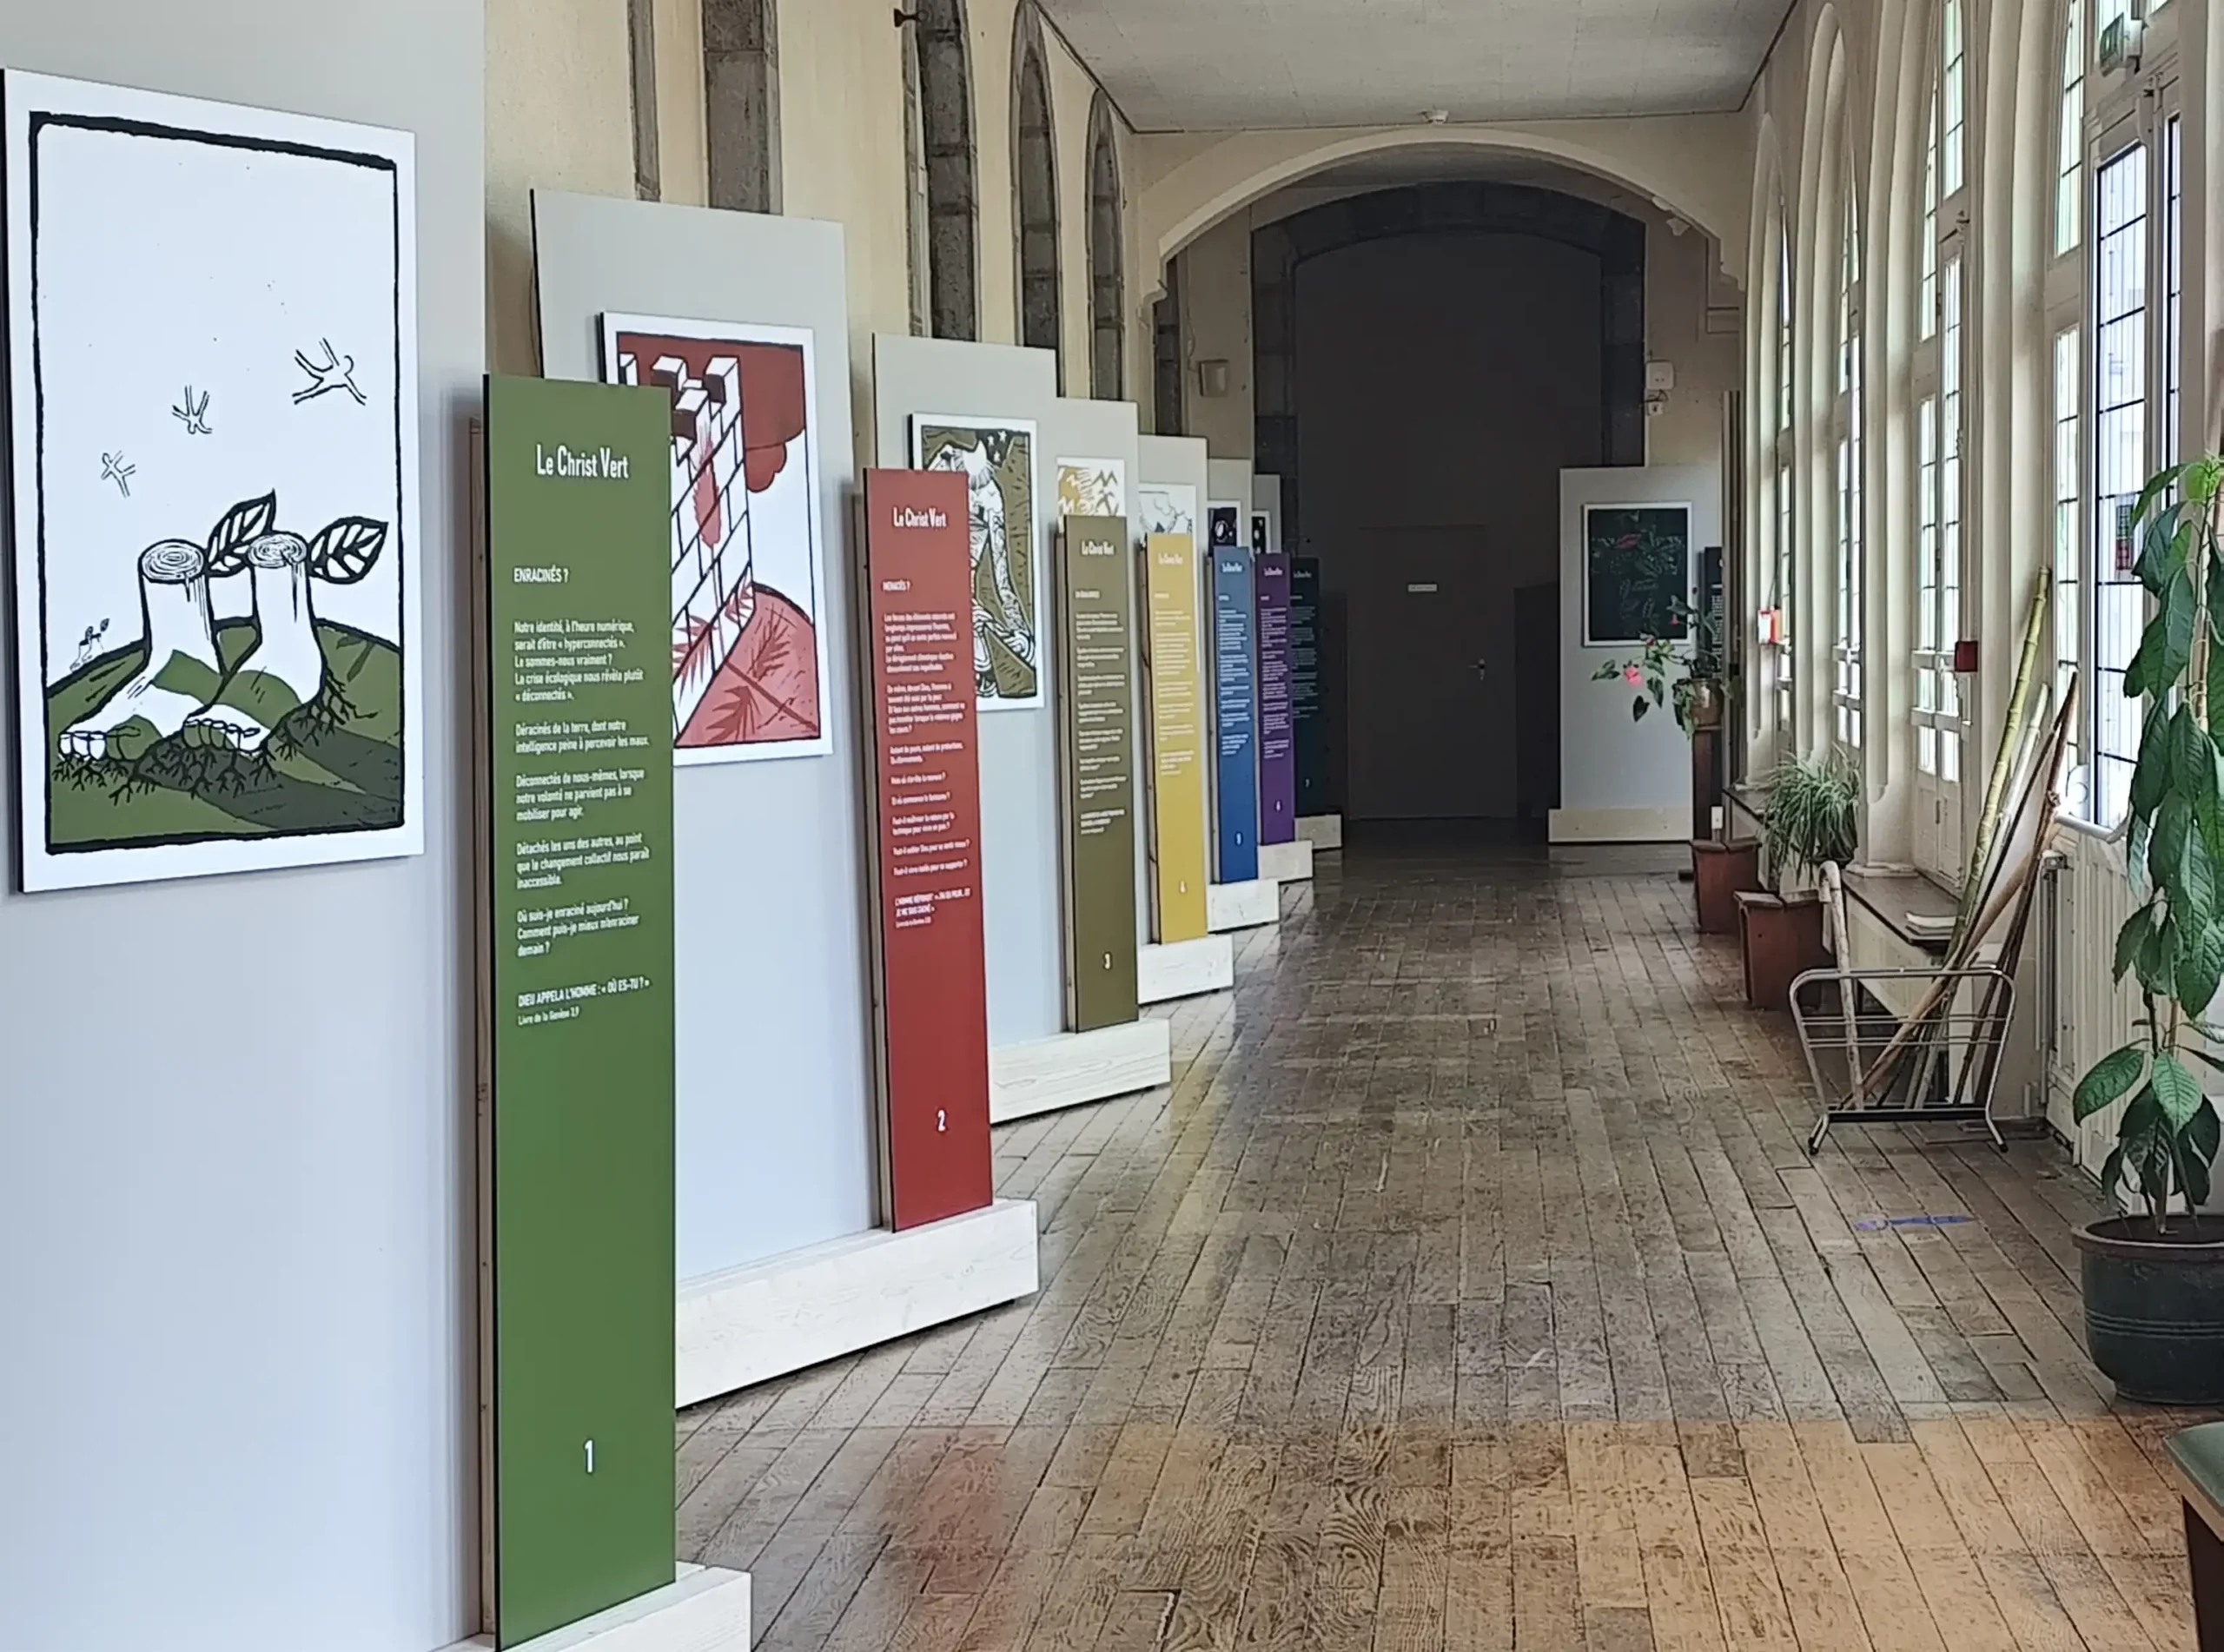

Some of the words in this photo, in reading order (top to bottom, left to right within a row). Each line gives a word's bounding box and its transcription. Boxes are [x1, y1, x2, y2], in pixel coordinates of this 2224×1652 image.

[536, 444, 554, 475] Le
[558, 445, 598, 478] Christ
[600, 447, 628, 479] Vert
[905, 508, 929, 527] Christ
[929, 508, 946, 527] Vert
[513, 565, 561, 583] ENRACINÉS
[564, 567, 569, 582] ?
[519, 994, 535, 1007] DIEU
[537, 988, 564, 1004] APPELA
[938, 1110, 945, 1131] 2
[585, 1440, 592, 1473] 1
